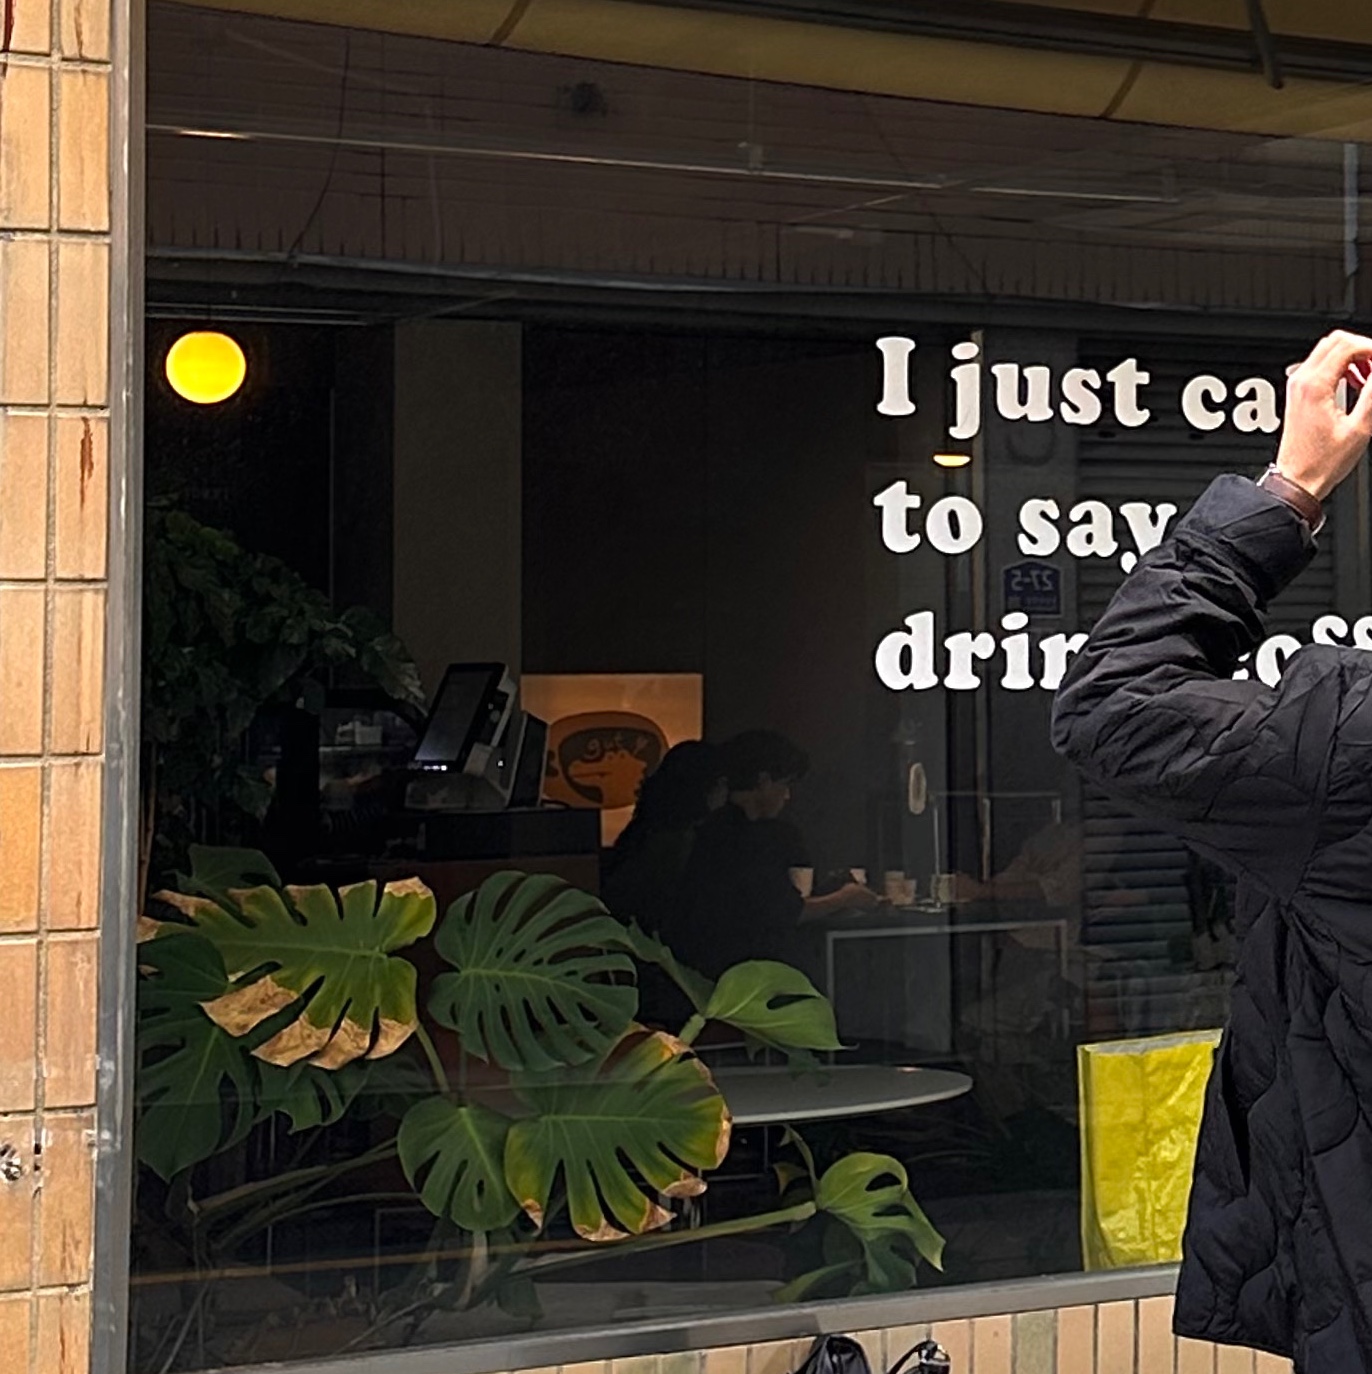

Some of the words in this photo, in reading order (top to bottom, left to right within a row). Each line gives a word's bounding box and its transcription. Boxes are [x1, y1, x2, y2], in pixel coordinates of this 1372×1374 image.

[875, 336, 916, 416] I
[948, 341, 1151, 440] just
[873, 480, 983, 554] to
[1017, 499, 1178, 574] say
